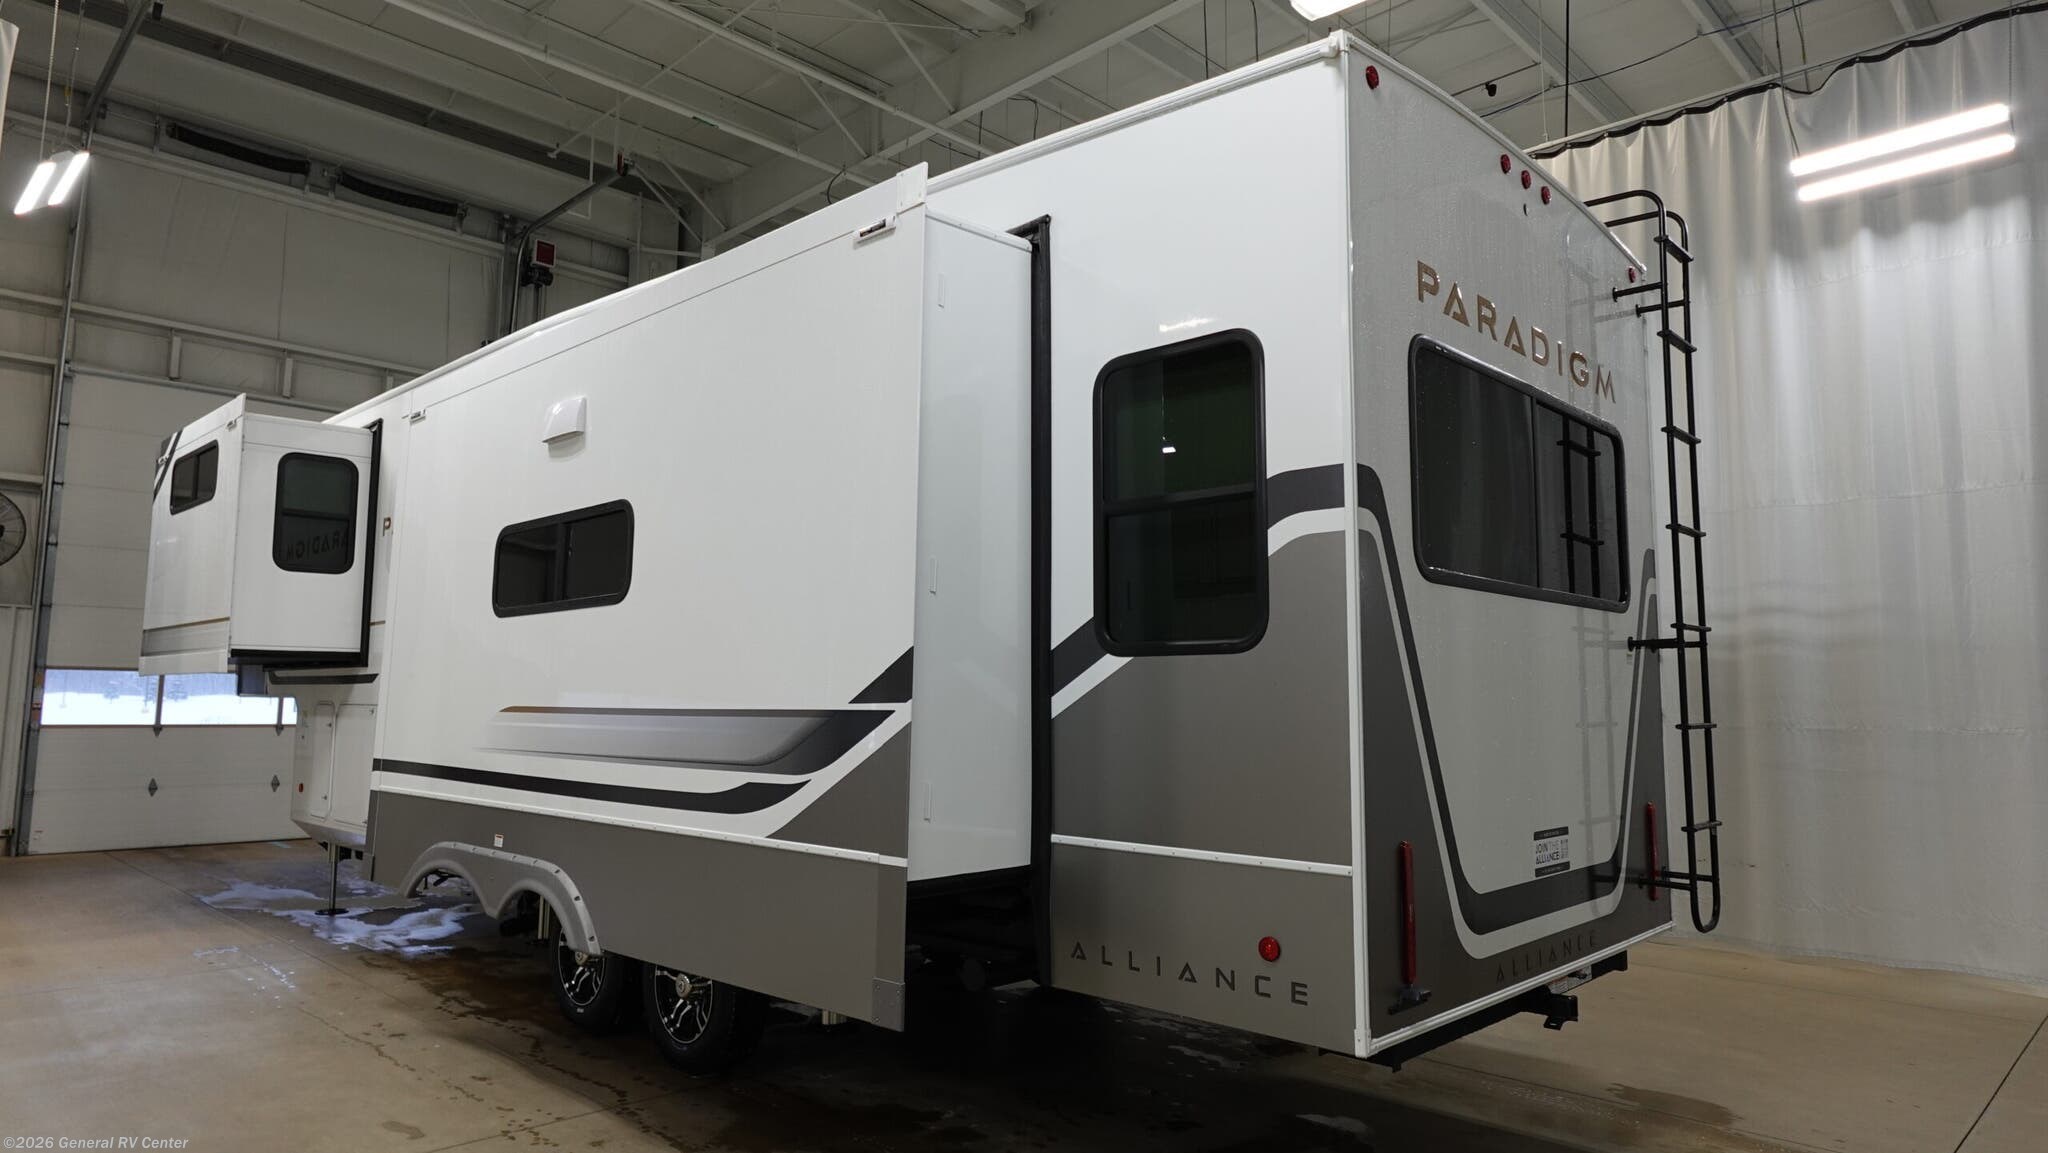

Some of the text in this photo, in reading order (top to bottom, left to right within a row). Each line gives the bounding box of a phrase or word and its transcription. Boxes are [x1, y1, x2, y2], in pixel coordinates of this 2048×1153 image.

[1417, 260, 1616, 404] PARADIGM
[1536, 851, 1560, 864] ALLIANCE
[1071, 941, 1308, 1006] ALLIANCE
[1497, 929, 1598, 984] ALLIANCE
